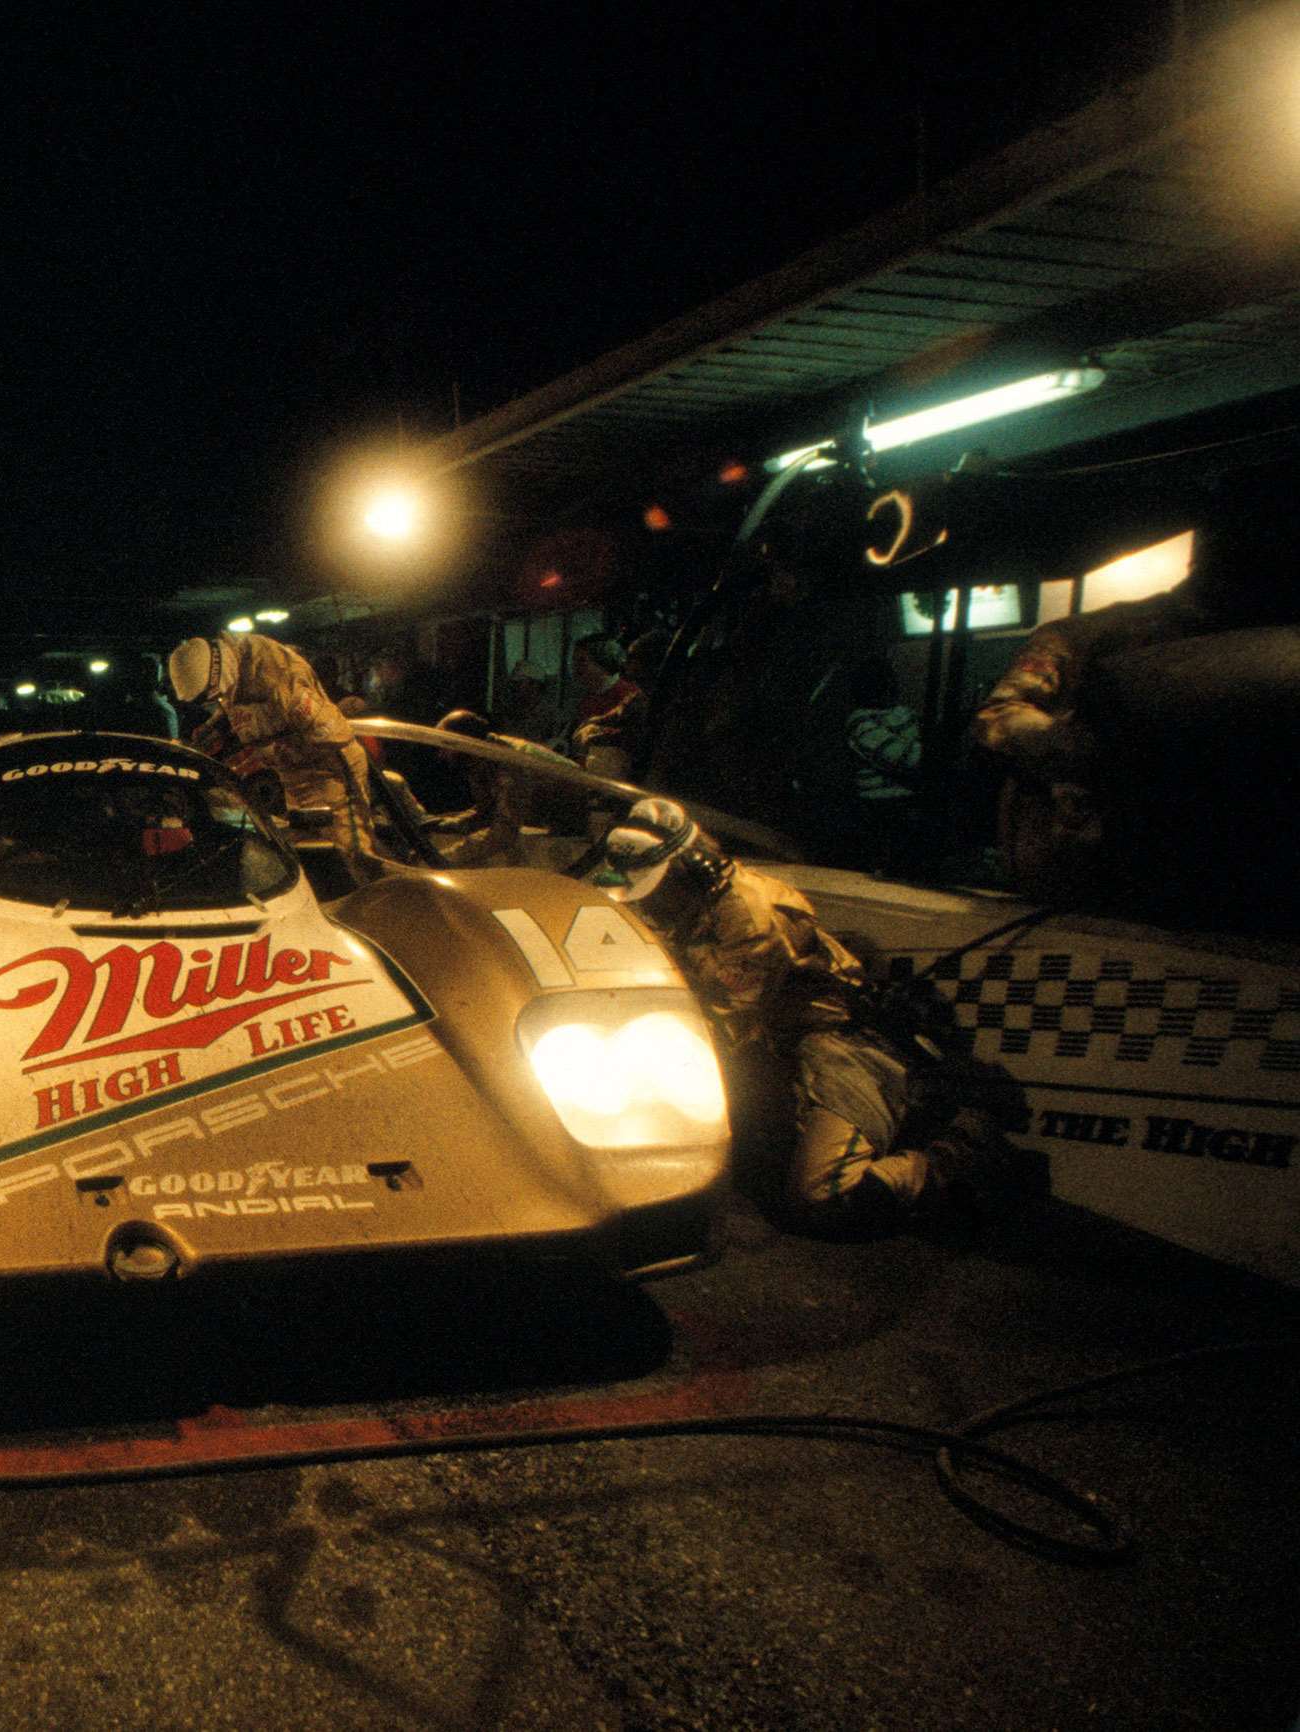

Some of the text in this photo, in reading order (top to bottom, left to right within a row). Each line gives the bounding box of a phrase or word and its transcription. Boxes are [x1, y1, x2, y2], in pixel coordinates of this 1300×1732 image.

[2, 758, 199, 781] GOODYEAR
[492, 905, 680, 988] 14
[33, 1004, 356, 1129] HIGH LIFE
[1041, 1111, 1131, 1146] THE
[1143, 1116, 1293, 1168] HIGH
[129, 1161, 369, 1195] GOODYEAR
[152, 1195, 374, 1219] ANDIAL
